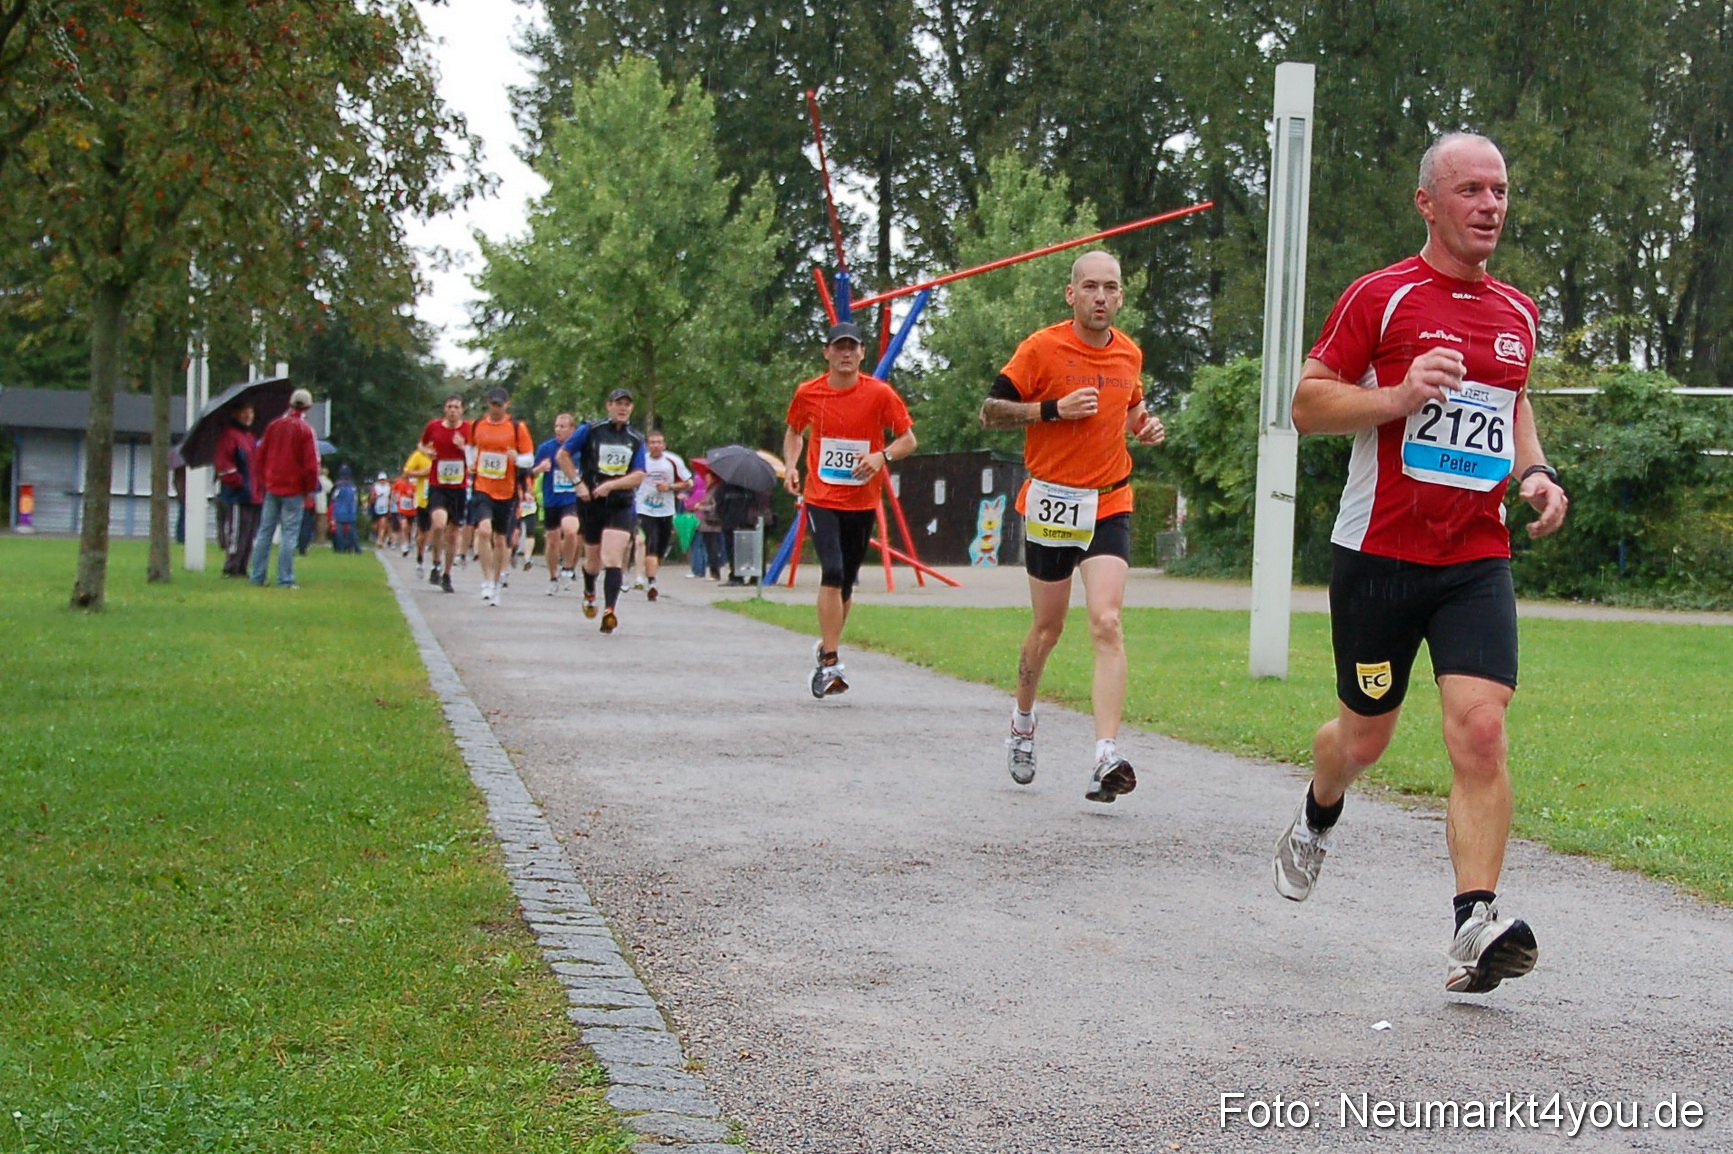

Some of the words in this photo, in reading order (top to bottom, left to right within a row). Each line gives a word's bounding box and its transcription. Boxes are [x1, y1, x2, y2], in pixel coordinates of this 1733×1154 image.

[1416, 403, 1505, 453] 2126
[606, 453, 626, 465] 234
[1439, 453, 1478, 474] Peter
[1038, 498, 1079, 527] 321
[1362, 673, 1387, 689] FC
